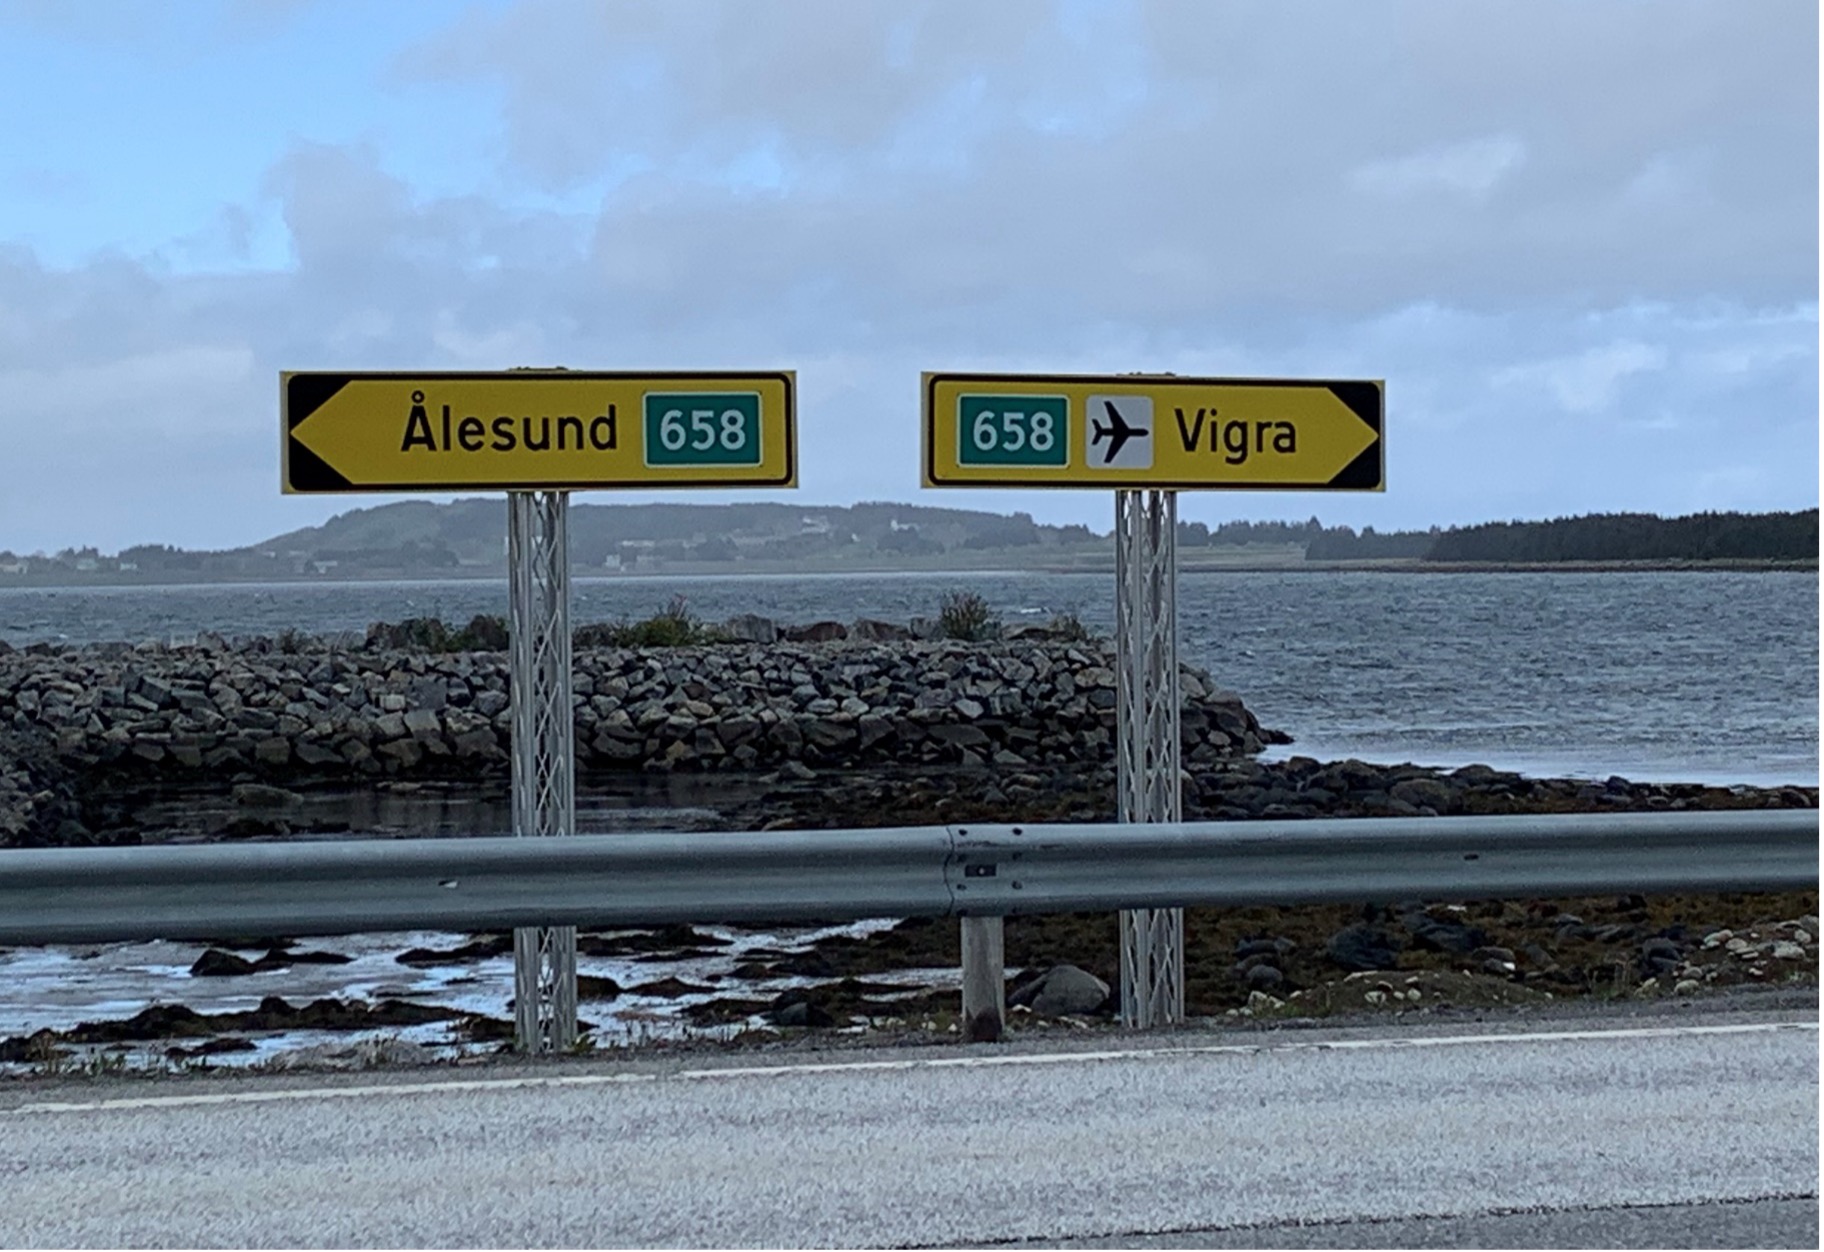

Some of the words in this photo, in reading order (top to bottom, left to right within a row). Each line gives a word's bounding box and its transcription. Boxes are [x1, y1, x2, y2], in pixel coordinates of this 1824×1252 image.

[400, 390, 618, 453] Ålesund
[659, 408, 747, 451] 658
[972, 410, 1055, 452] 658
[1174, 407, 1297, 465] Vigra
